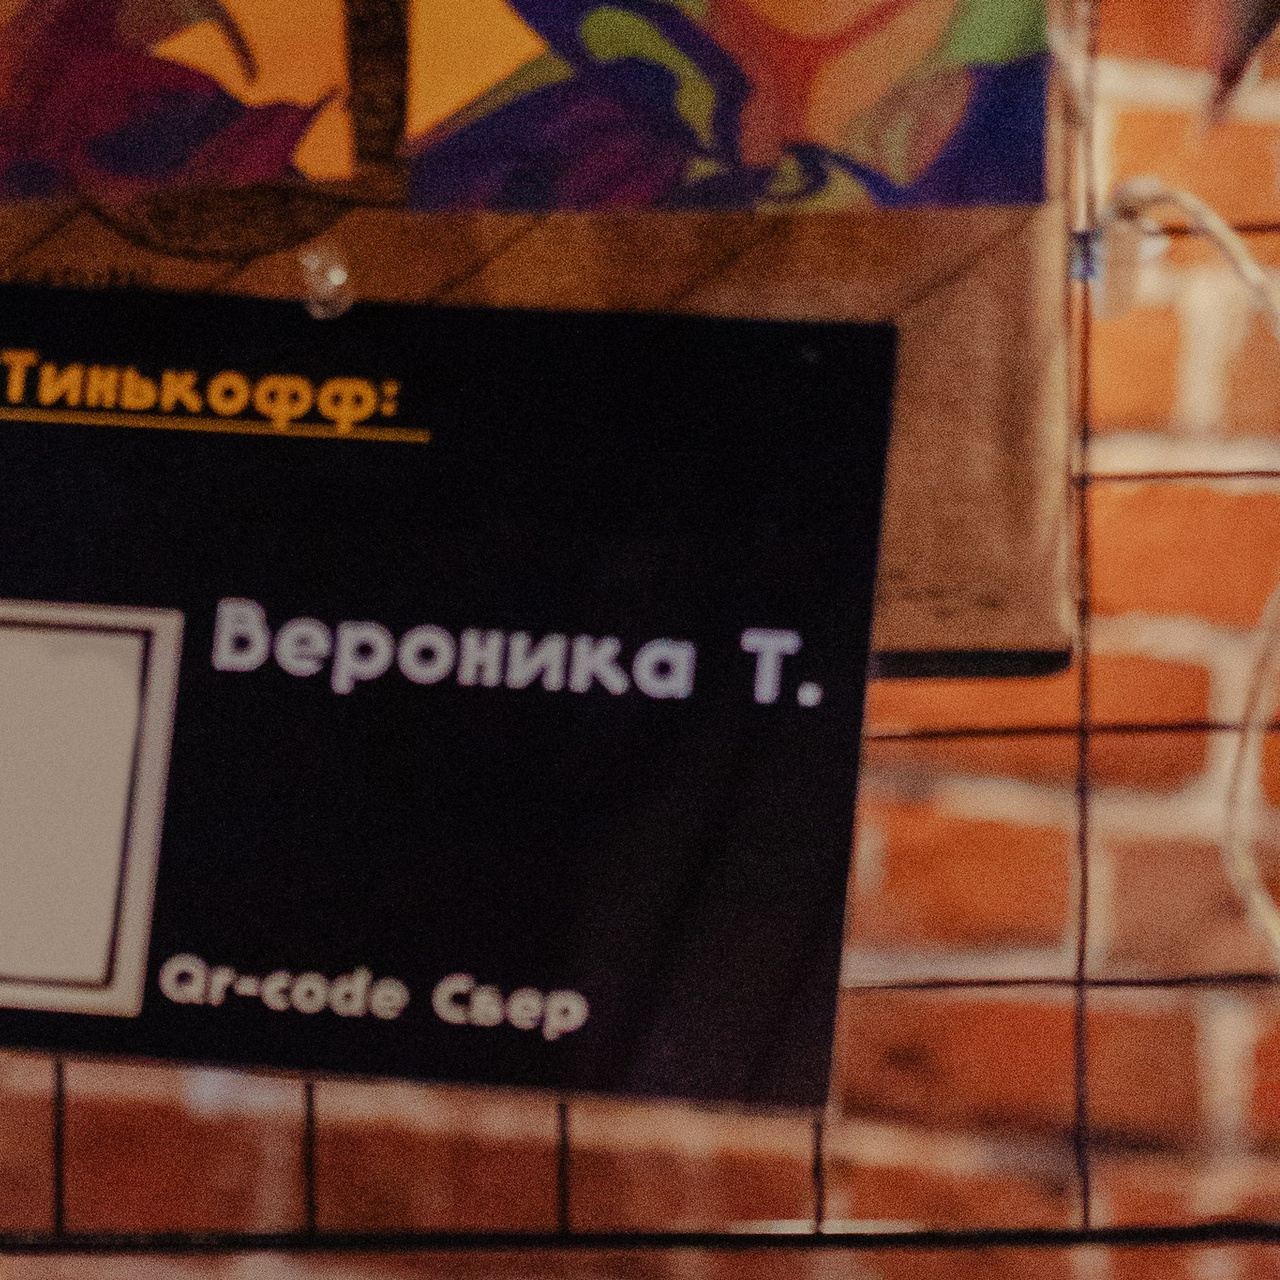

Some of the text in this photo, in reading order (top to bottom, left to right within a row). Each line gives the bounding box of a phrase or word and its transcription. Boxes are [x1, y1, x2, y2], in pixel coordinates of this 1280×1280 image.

[212, 598, 823, 706] Вероника Т.
[158, 952, 410, 1020] Qr-code
